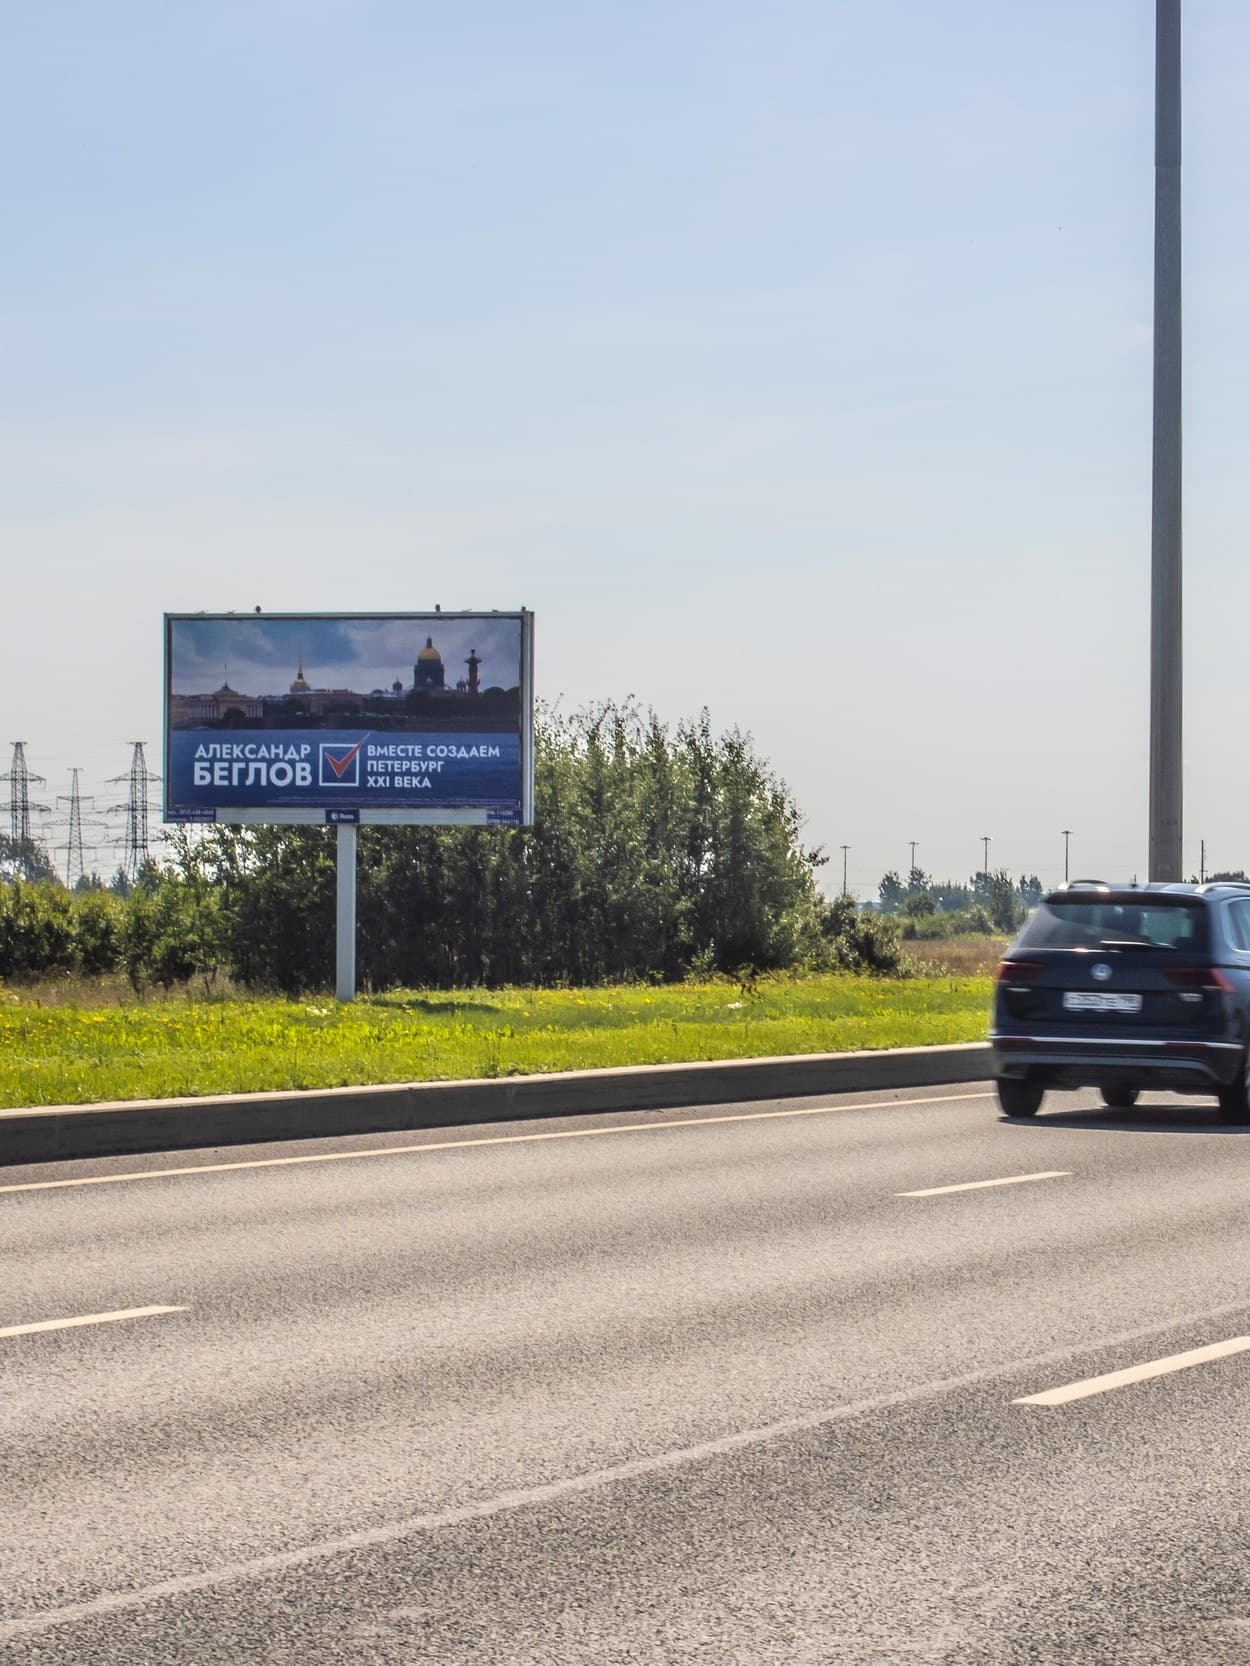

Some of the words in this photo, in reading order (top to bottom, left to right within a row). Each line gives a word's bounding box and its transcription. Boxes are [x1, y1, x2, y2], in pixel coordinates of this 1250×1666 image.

[194, 743, 311, 761] АЛЕКСАНДР
[367, 745, 422, 757] ВМЕСТЕ
[426, 745, 500, 759] СОЗДАЕМ
[367, 760, 445, 773] ПЕТЕРБУРГ
[193, 761, 313, 787] БЕГЛОВ
[367, 776, 390, 788] XXI
[394, 776, 432, 788] ВЕКА
